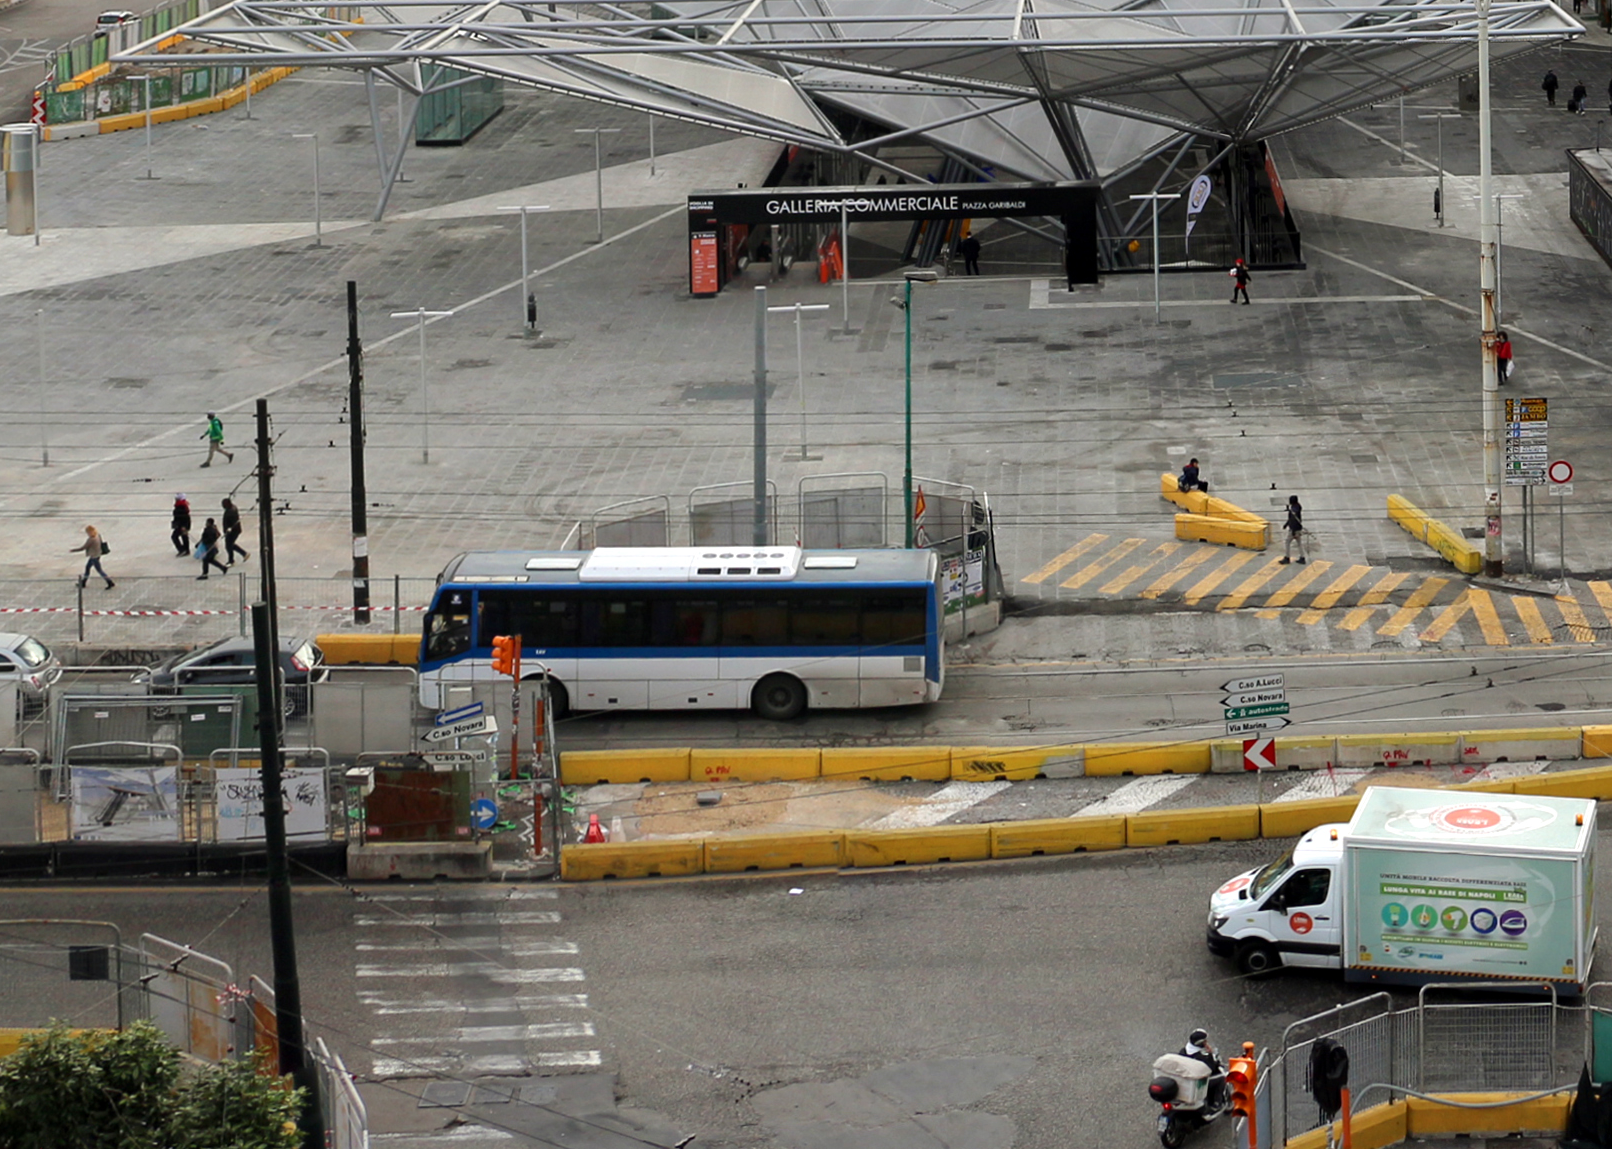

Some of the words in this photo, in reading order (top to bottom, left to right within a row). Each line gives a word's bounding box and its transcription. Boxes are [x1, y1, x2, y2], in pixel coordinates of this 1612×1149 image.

[766, 198, 841, 215] GALLERIA
[845, 195, 959, 213] COMMERCIALE
[962, 202, 987, 210] PIAZZA
[988, 201, 1027, 210] GARIBALDI
[1238, 681, 1255, 690] C.so
[1255, 676, 1283, 687] A.Lucci
[1240, 696, 1256, 704] C.so
[1257, 692, 1283, 702] Novara
[453, 720, 483, 734] Novara
[1229, 724, 1241, 732] Via
[1242, 722, 1267, 731] Marina
[459, 752, 485, 761] Luci
[1468, 891, 1496, 899] NAPOLI
